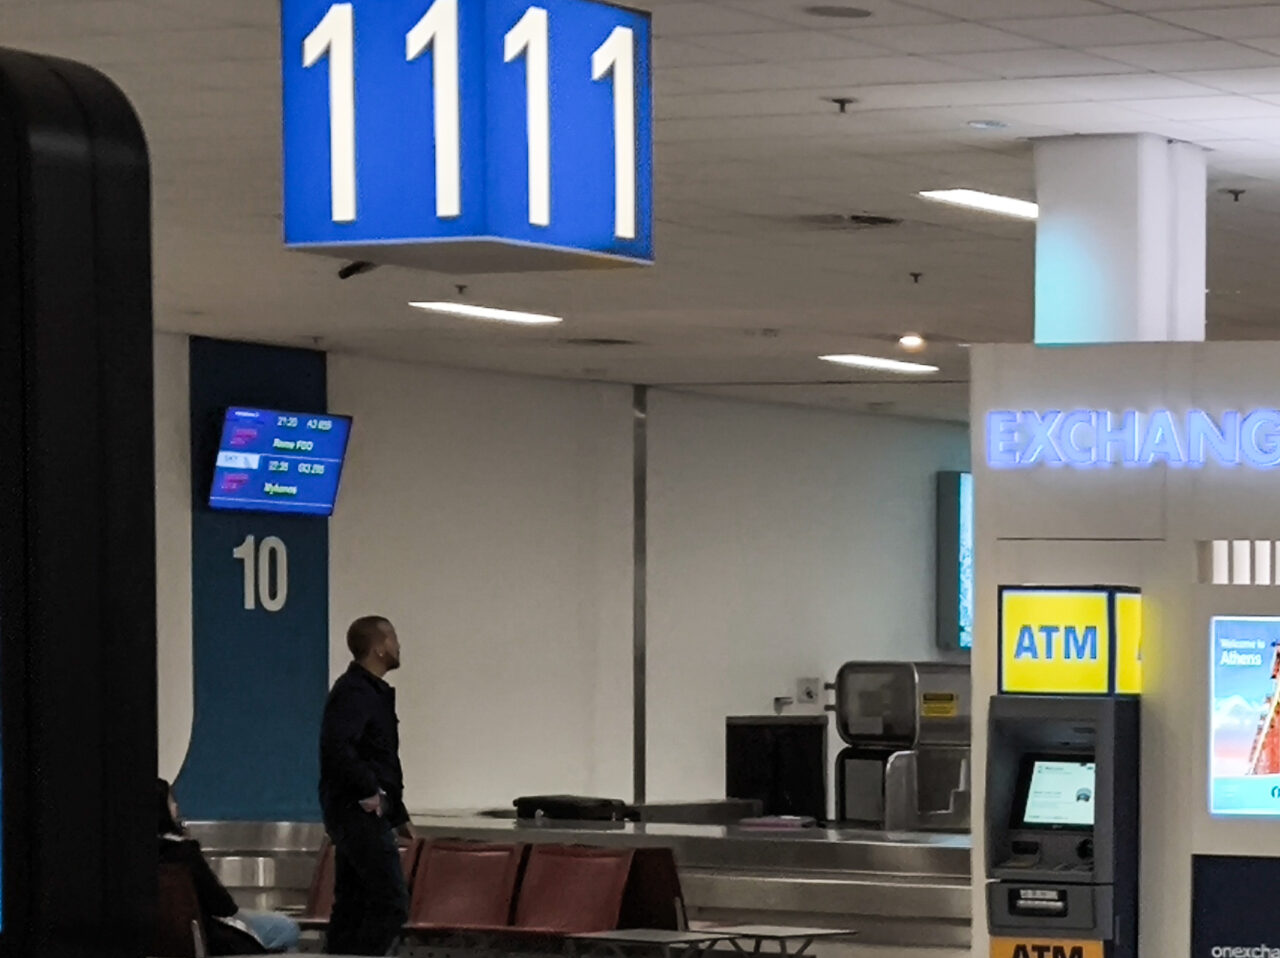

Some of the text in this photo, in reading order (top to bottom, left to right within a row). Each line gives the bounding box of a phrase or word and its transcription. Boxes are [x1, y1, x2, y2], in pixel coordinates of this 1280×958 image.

[233, 534, 288, 612] 10
[1014, 624, 1098, 660] ATM
[1220, 650, 1262, 666] Athens
